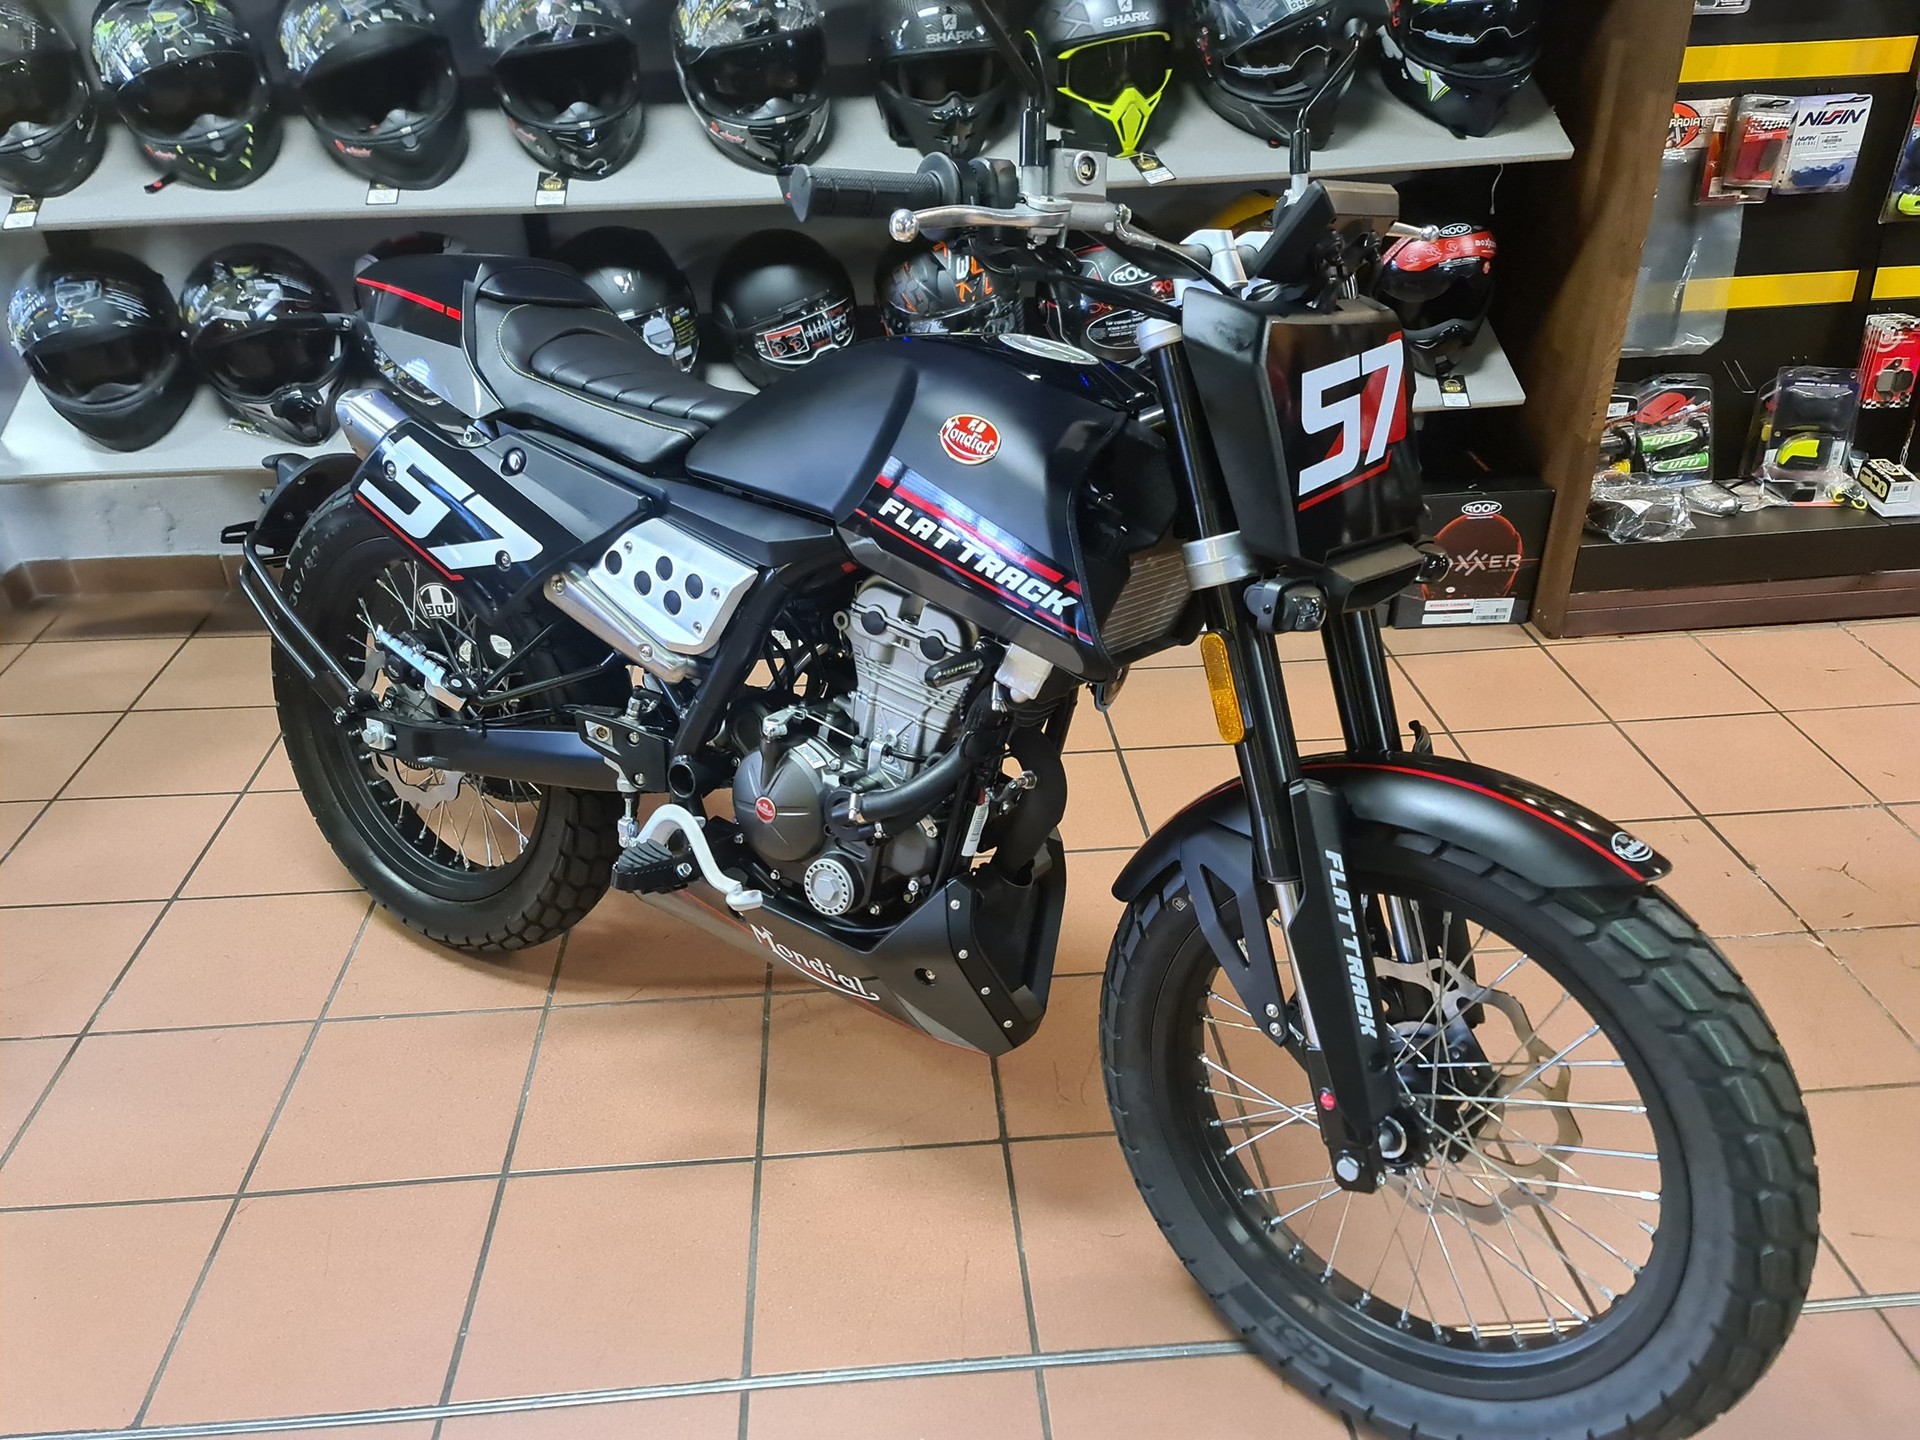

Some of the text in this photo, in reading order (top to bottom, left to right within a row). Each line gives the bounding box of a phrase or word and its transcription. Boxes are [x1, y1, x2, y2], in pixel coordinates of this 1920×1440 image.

[1103, 11, 1150, 28] SHARK
[926, 29, 976, 44] SHARK
[1669, 117, 1714, 129] RADIATO
[1442, 225, 1469, 235] ROOF
[1299, 339, 1404, 496] 57
[939, 418, 997, 458] Mondial
[1668, 457, 1701, 470] UFO
[358, 435, 543, 570] 57
[1465, 503, 1498, 513] ROOF
[878, 498, 1078, 616] FLAT TRACK
[1450, 549, 1521, 576] XXER
[1325, 849, 1378, 1039] FLAT TRACK
[750, 923, 880, 1001] Mondial
